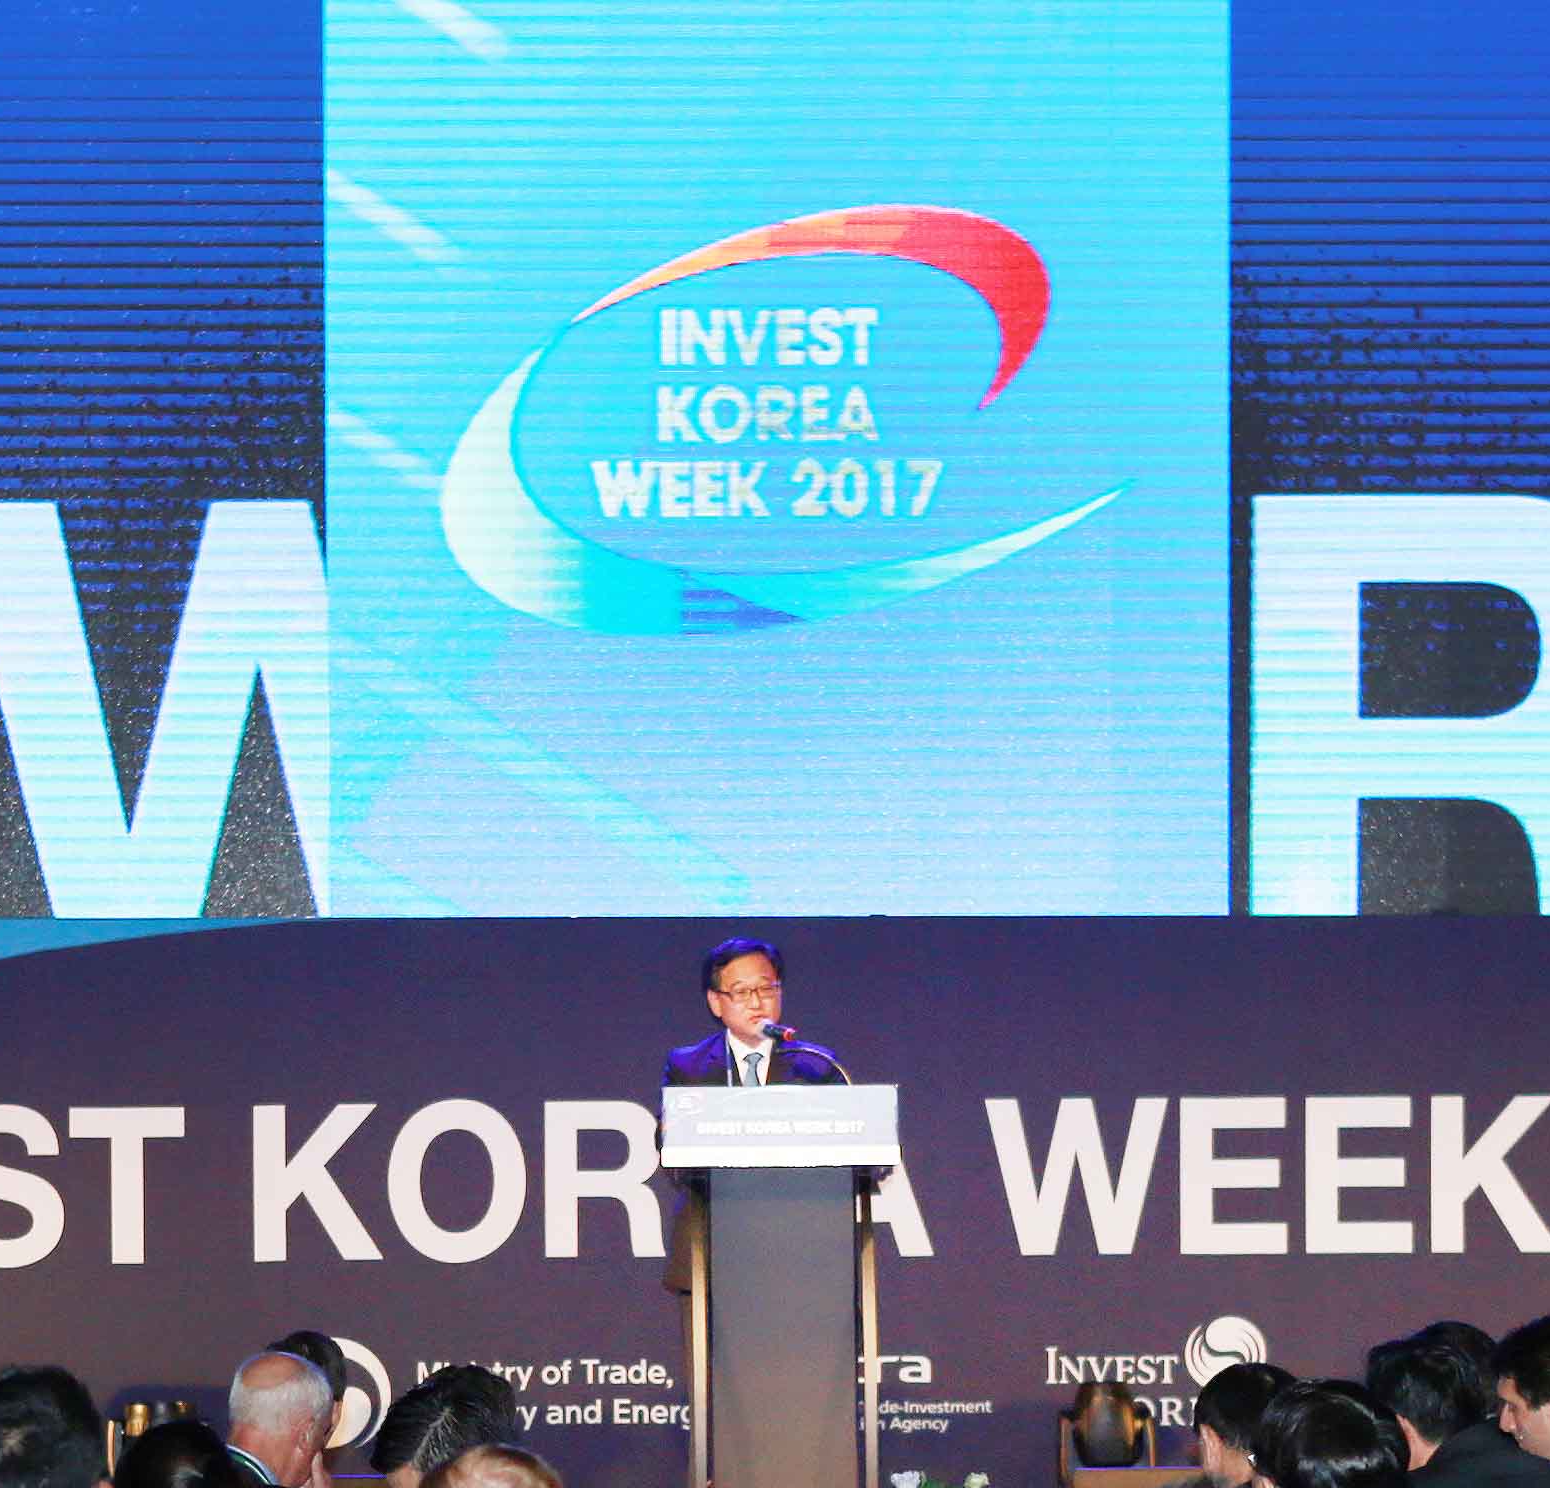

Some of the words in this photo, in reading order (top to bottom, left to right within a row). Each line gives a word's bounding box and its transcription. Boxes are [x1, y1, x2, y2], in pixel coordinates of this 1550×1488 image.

[659, 306, 879, 367] INVEST
[656, 384, 880, 444] KOREA
[590, 458, 772, 519] WEEK
[790, 457, 945, 519] 2017
[252, 1098, 935, 1264] KOR
[541, 1359, 572, 1385] of
[579, 1358, 675, 1389] Trade,
[1045, 1345, 1179, 1385] INVEST
[546, 1399, 603, 1425] and
[613, 1398, 691, 1430] Energ
[889, 1416, 950, 1434] Agency
